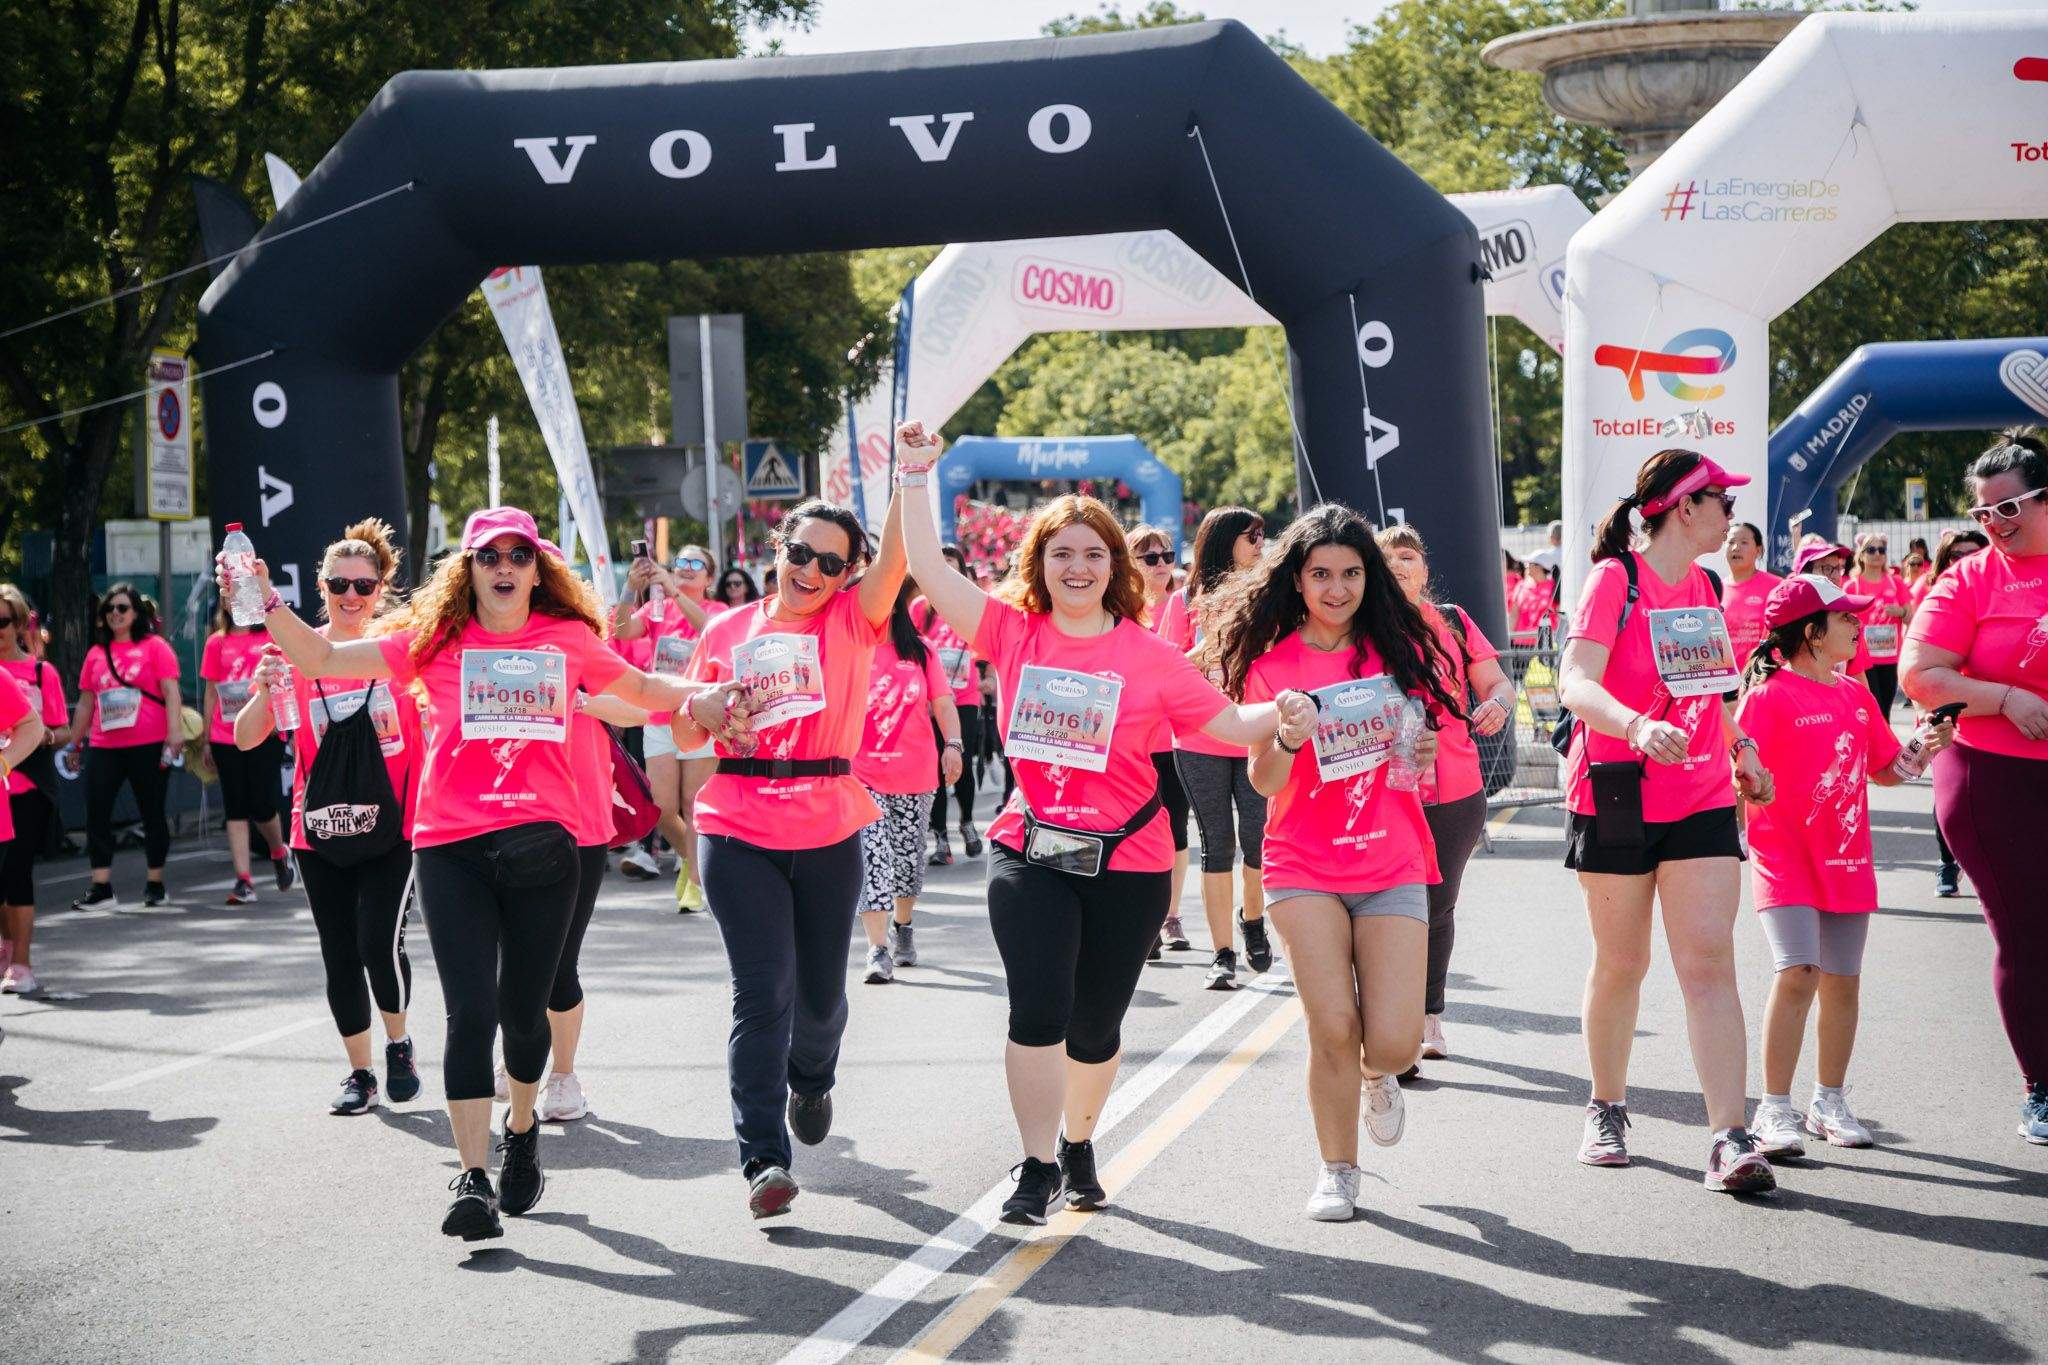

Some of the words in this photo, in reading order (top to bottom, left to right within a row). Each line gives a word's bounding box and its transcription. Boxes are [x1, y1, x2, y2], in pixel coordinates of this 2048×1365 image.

[513, 104, 1092, 184] VOLVO
[1701, 201, 1838, 222] LasCarreras
[1022, 264, 1114, 311] COSMO
[1806, 393, 1868, 455] MADRID
[2004, 577, 2043, 592] OYSHO
[1681, 645, 1710, 661] 016
[760, 670, 791, 690] 016
[497, 688, 536, 704] 016
[504, 706, 527, 714] 24718
[1043, 710, 1080, 729] 016
[1345, 716, 1385, 738] 016
[1794, 712, 1833, 728] OYSHO
[474, 724, 507, 733] OYSHO
[1045, 729, 1068, 740] 24720
[1017, 733, 1039, 742] CARRERA
[1355, 736, 1379, 748] 24721
[1014, 744, 1045, 756] OYSHO
[1330, 751, 1354, 762] CARRERA
[1332, 760, 1364, 774] OYSHO
[327, 806, 354, 819] VANS
[331, 818, 354, 833] THE
